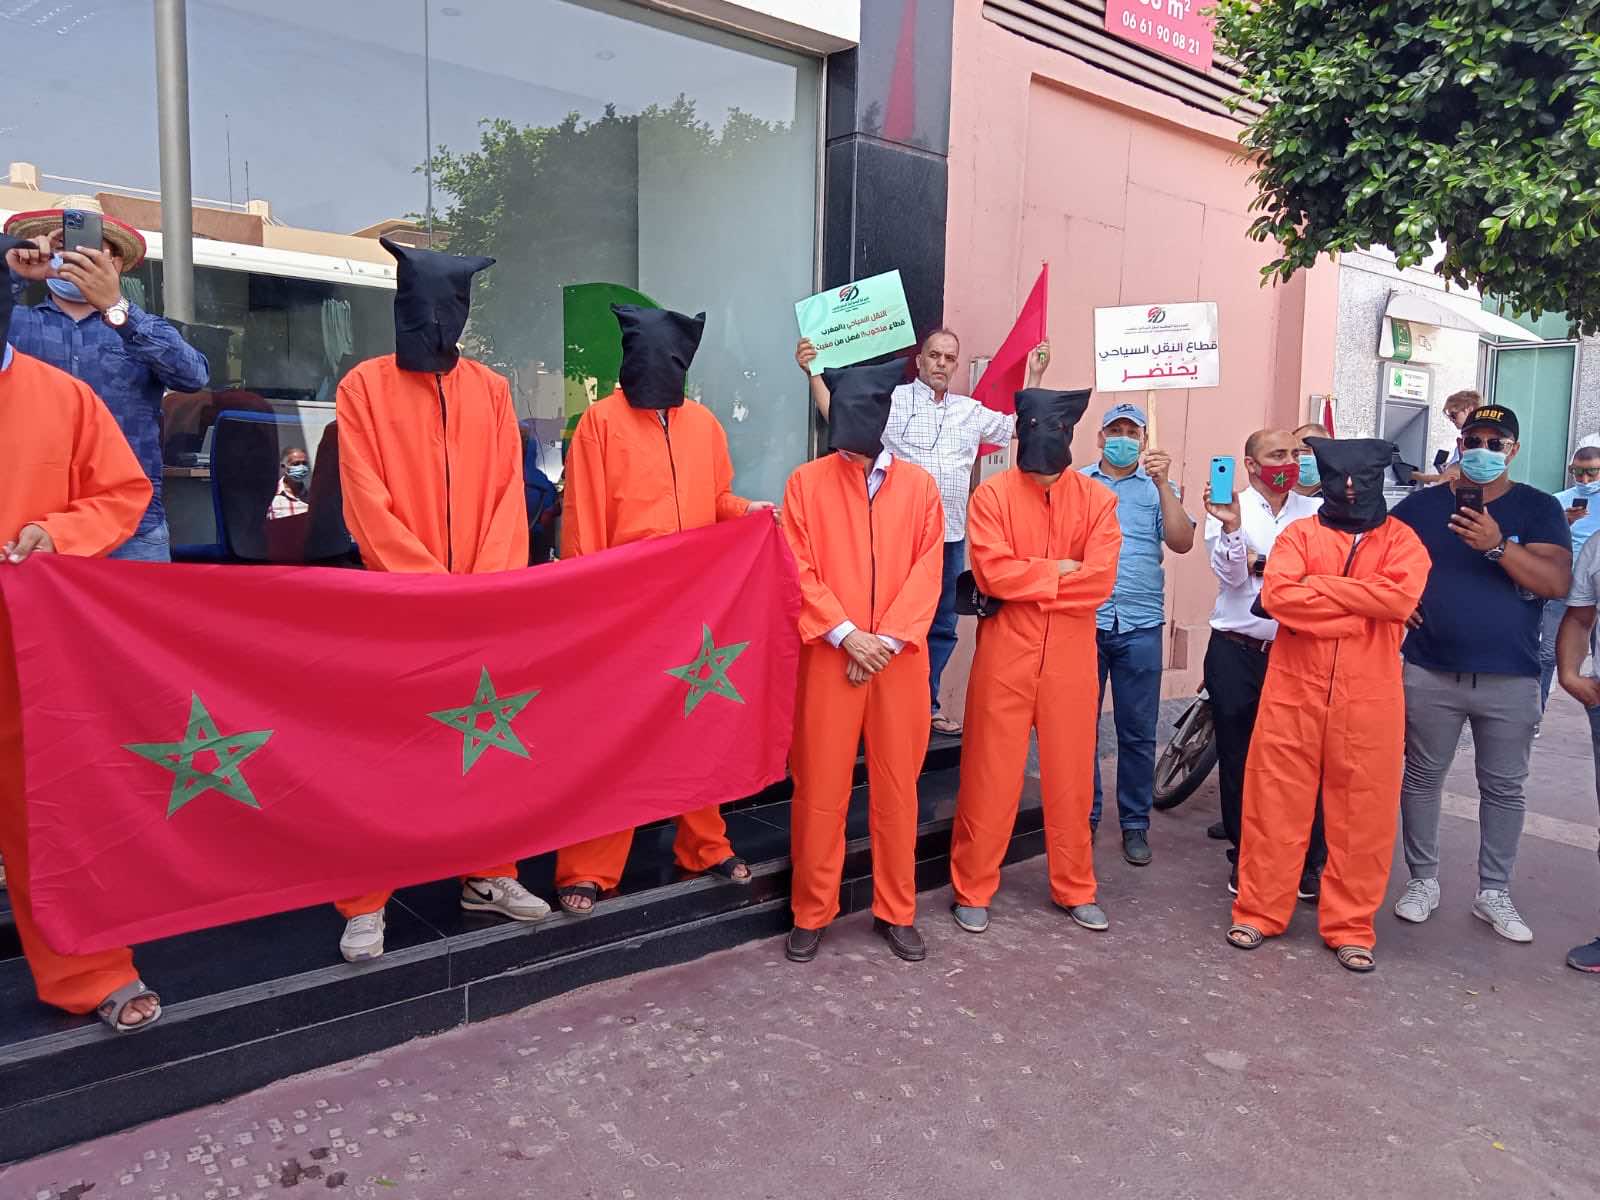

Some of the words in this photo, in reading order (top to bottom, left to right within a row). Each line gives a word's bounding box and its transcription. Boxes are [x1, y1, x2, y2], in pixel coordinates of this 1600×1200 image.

[1122, 10, 1137, 29] 06
[1139, 19, 1152, 36] 61
[1156, 25, 1170, 43] 90
[1172, 31, 1186, 50] 08
[1188, 38, 1200, 56] 21
[846, 315, 870, 329] السياحي
[870, 310, 888, 322] النقل
[888, 319, 906, 331] قطاع
[1098, 344, 1149, 361] السياحي
[1151, 342, 1183, 355] النقل
[1186, 339, 1218, 353] قطاع
